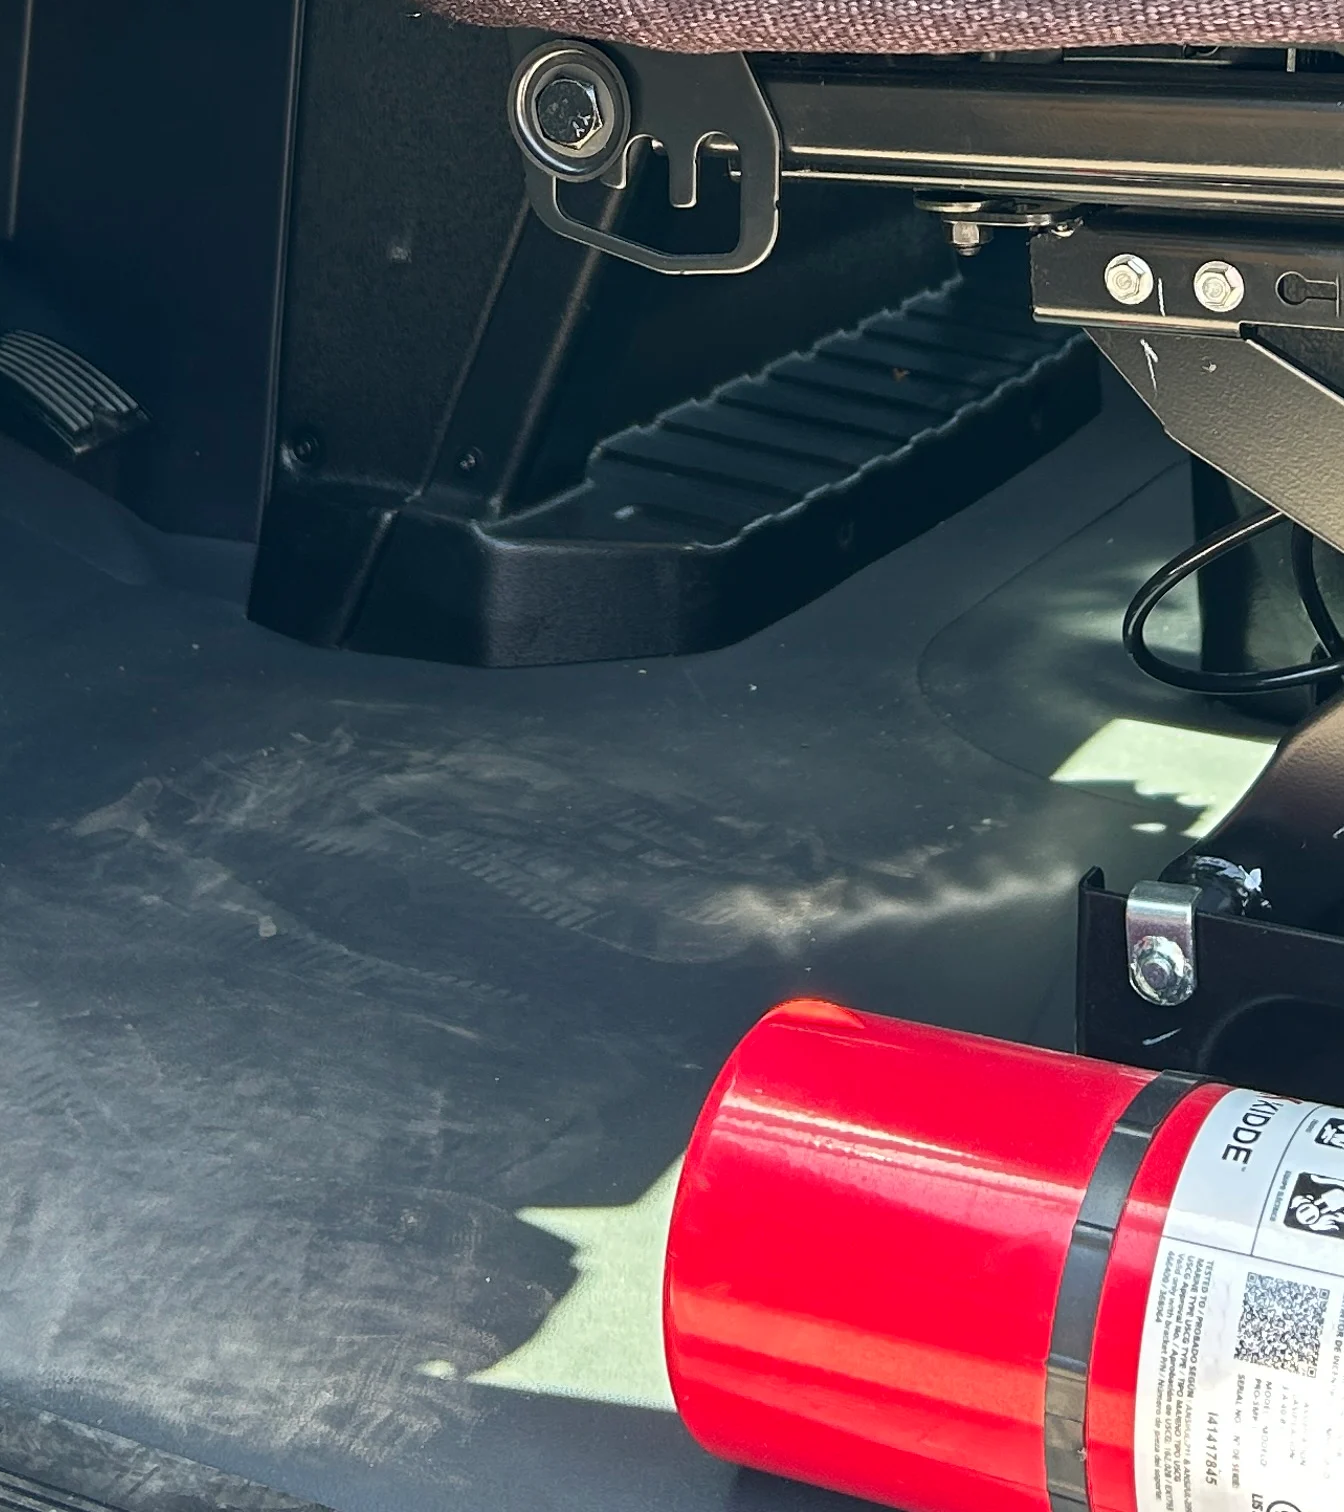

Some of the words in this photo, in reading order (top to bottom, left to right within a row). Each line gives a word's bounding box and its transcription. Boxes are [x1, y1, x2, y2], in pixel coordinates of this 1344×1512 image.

[1222, 1099, 1285, 1166] KIDDE
[1183, 1254, 1194, 1279] USCG
[1201, 1259, 1214, 1293] TESTED
[1198, 1294, 1207, 1308] TO
[1182, 1318, 1192, 1344] USCG
[1190, 1315, 1203, 1363] PROBADO
